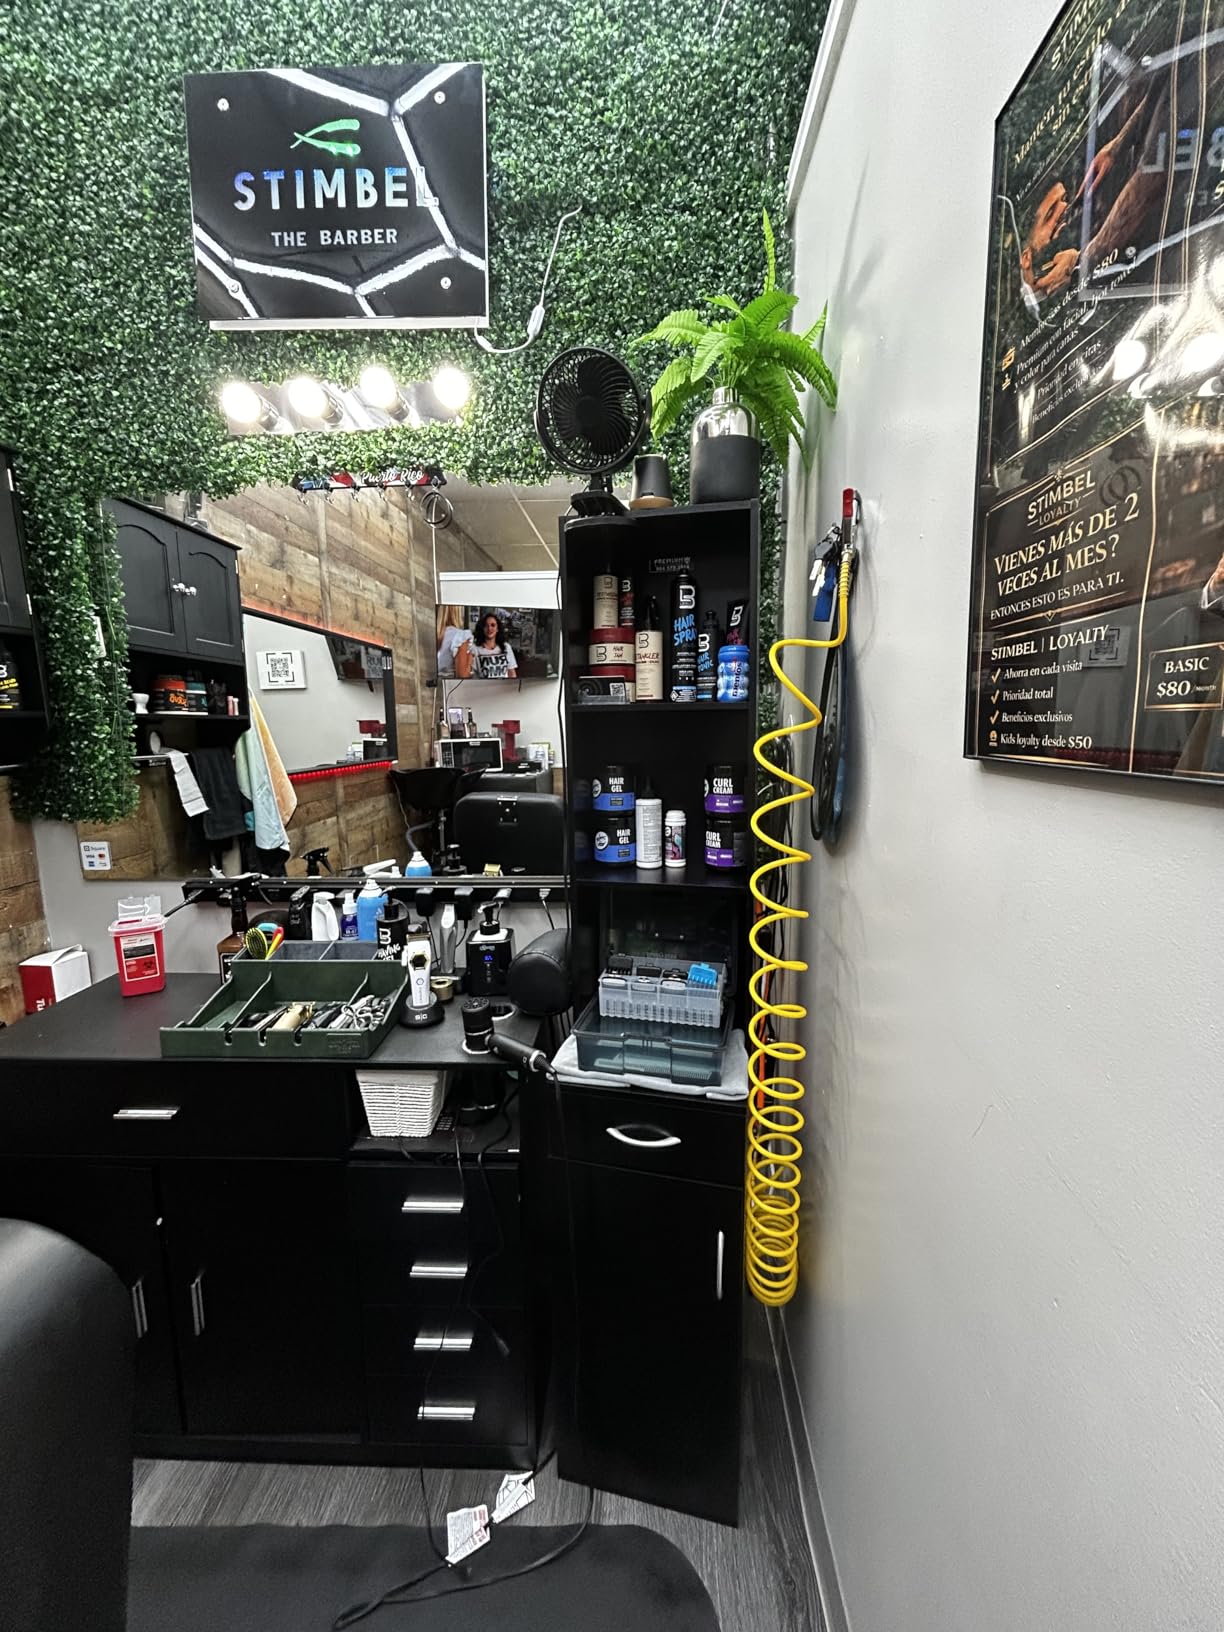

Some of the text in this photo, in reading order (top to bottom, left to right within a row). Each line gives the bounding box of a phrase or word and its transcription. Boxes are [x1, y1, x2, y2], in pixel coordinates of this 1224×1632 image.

[233, 165, 439, 212] STIMBEL
[271, 228, 398, 247] THE BARBER
[1062, 276, 1091, 306] desde
[1093, 248, 1118, 279] $80
[1016, 341, 1049, 375] Premium
[1049, 327, 1062, 345] con
[1020, 363, 1040, 385] color
[1041, 349, 1056, 373] para
[1056, 329, 1079, 353] canas
[360, 468, 424, 483] Puerto Rico
[1027, 470, 1096, 520] STIMBEL
[1039, 495, 1082, 526] LOYALTY
[994, 492, 1140, 576] VIENES MÁS DE 2
[997, 567, 1038, 597] VECES
[1039, 558, 1062, 583] AL
[990, 599, 1032, 620] ENTONCES
[1032, 591, 1056, 609] ESTO
[1058, 587, 1071, 601] ES
[1072, 577, 1104, 597] PARA
[674, 613, 695, 632] HAIR
[991, 641, 1038, 661] STIMBEL
[1049, 624, 1109, 651] LOYALTY
[1003, 659, 1083, 680] Ahorra en cada visita
[1164, 656, 1210, 674] BASIC
[1002, 686, 1054, 702] Prioridad total
[1156, 680, 1191, 699] $80
[1001, 710, 1074, 723] Beneficios exclusivos
[1000, 733, 1093, 750] Kids loyalty desde $50
[609, 777, 625, 785] HAIR
[611, 785, 623, 793] GEL
[713, 778, 733, 787] CURL
[713, 786, 733, 794] CREAM
[617, 829, 631, 837] HAIR
[618, 836, 630, 844] GEL
